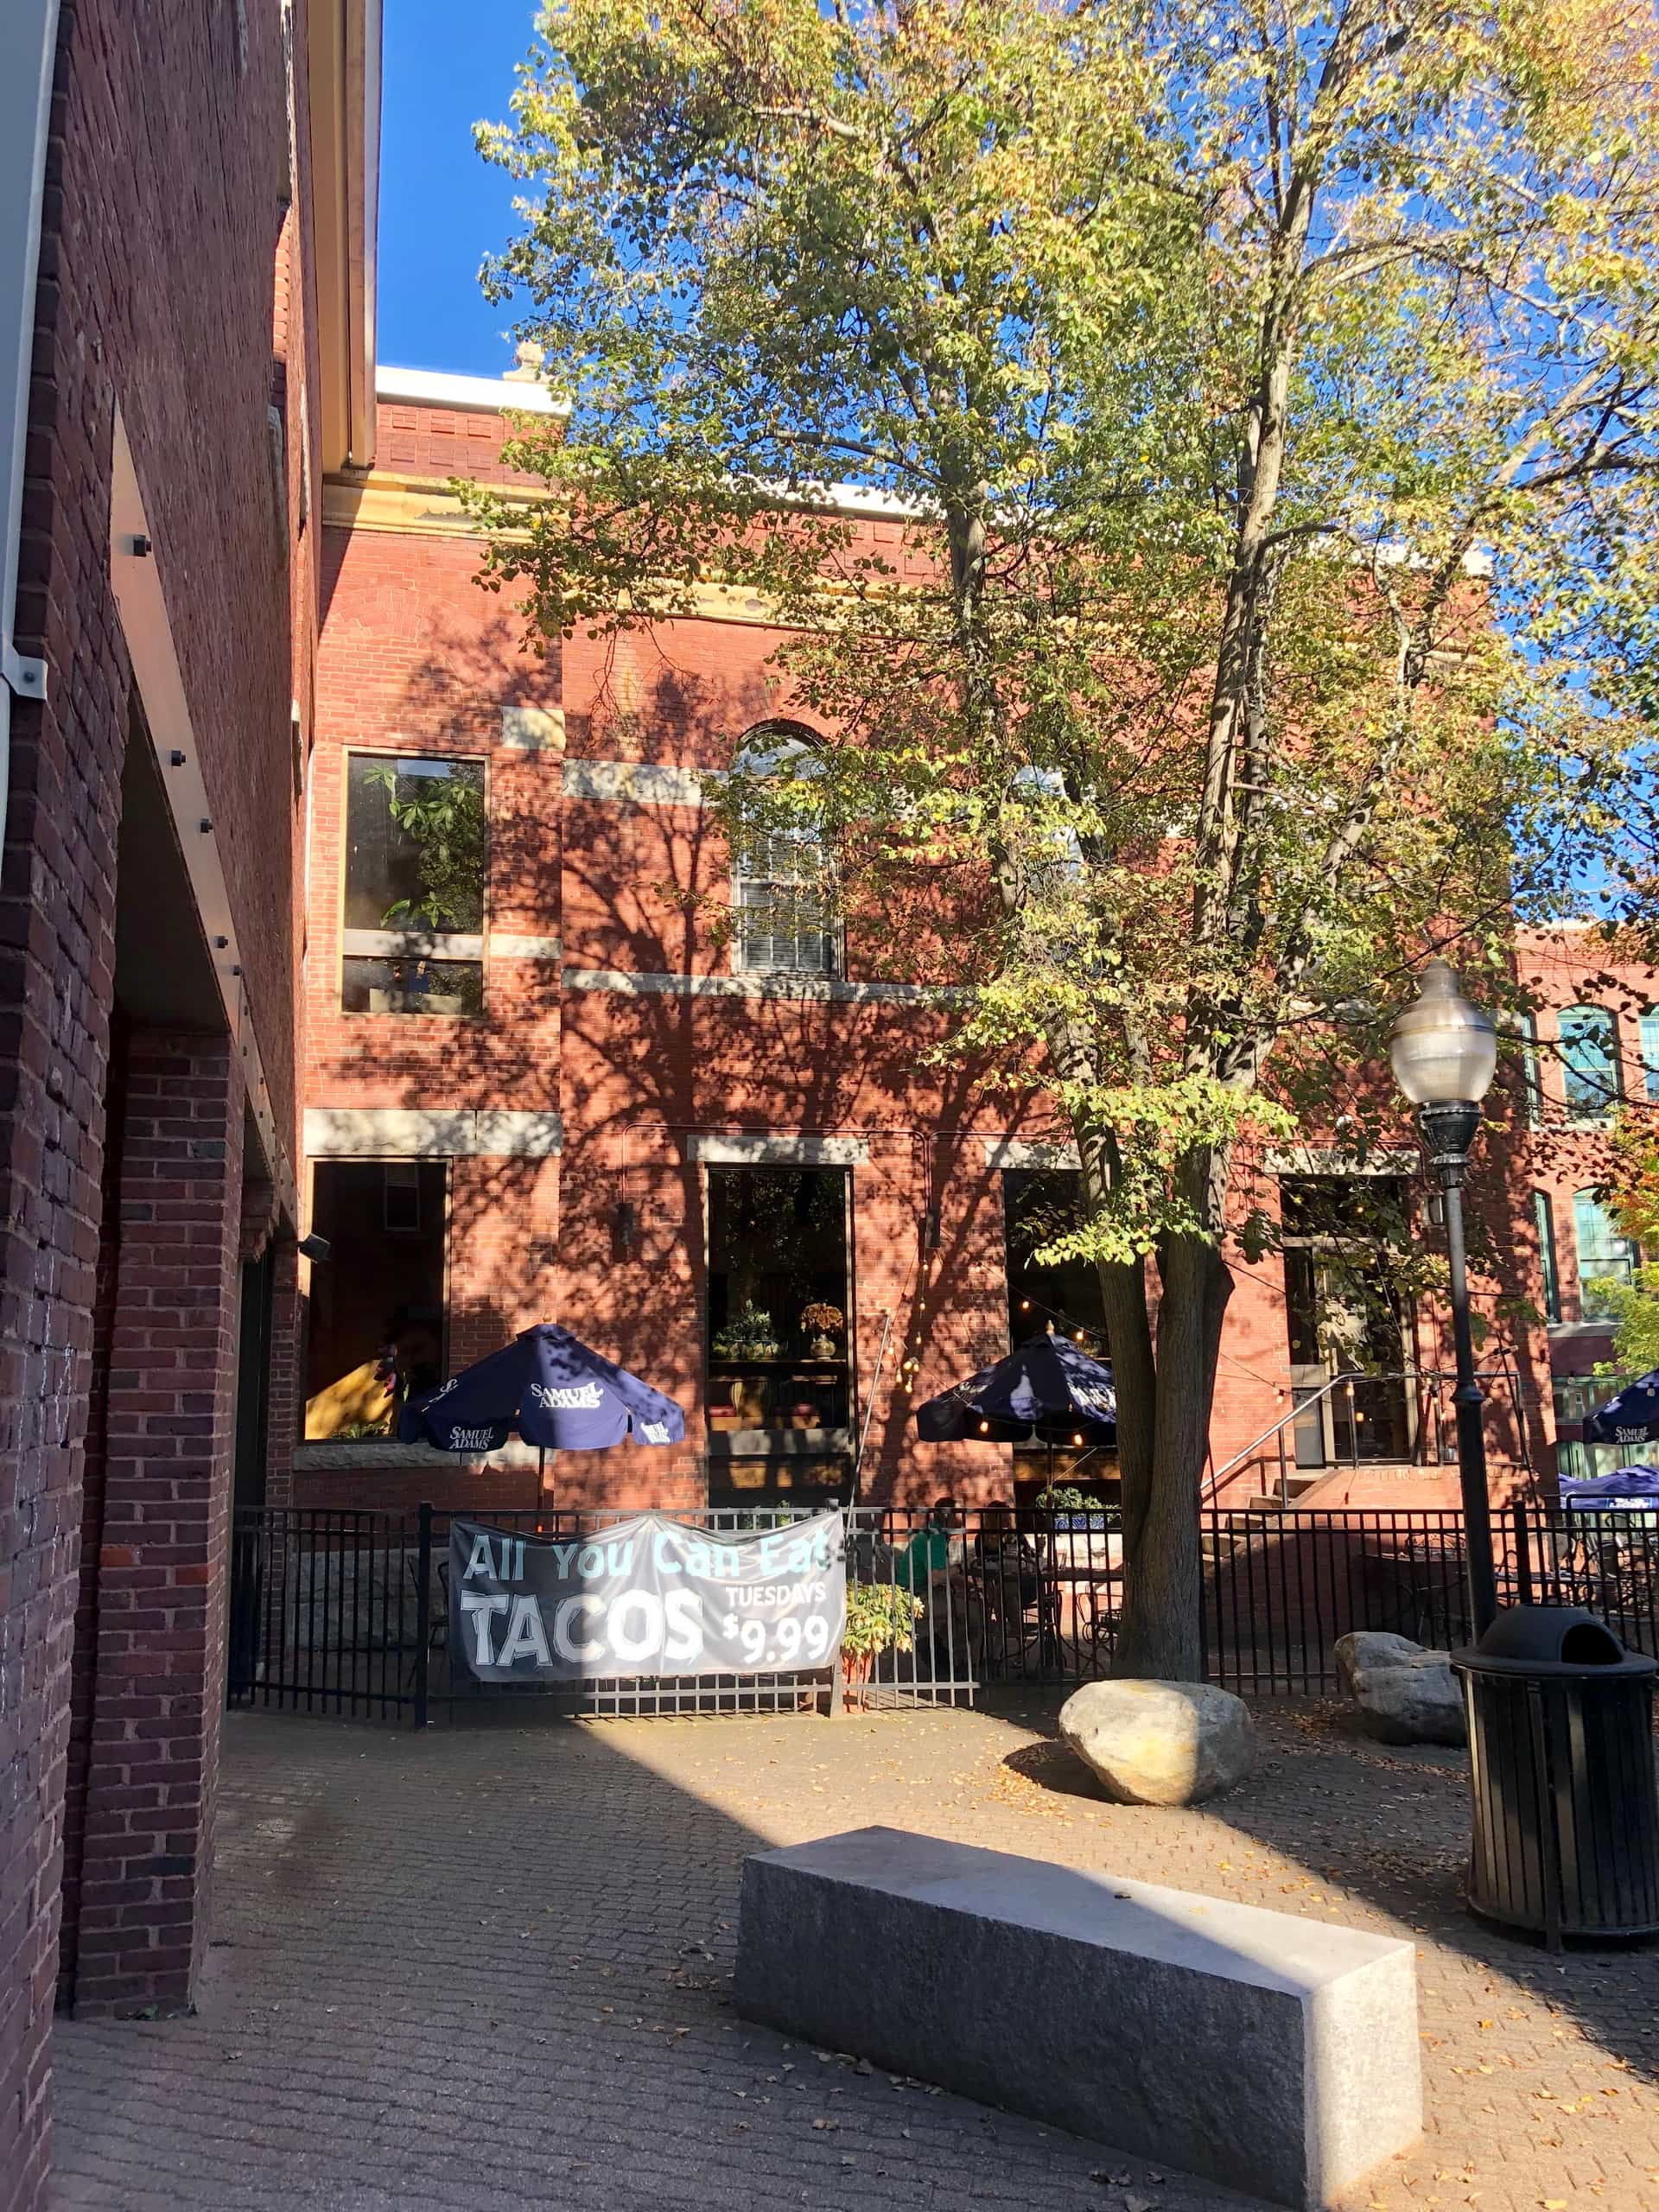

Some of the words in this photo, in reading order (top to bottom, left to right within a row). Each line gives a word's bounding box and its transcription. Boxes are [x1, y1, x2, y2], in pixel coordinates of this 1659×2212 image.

[448, 1438, 490, 1451] ADAMS
[449, 1426, 494, 1440] SAMUEL
[462, 1534, 526, 1581] All
[653, 1530, 740, 1577] Can
[760, 1529, 832, 1576] Eat
[725, 1581, 826, 1608] TUESDAYS
[460, 1587, 703, 1668] TACOS
[722, 1611, 830, 1664] $9.99
